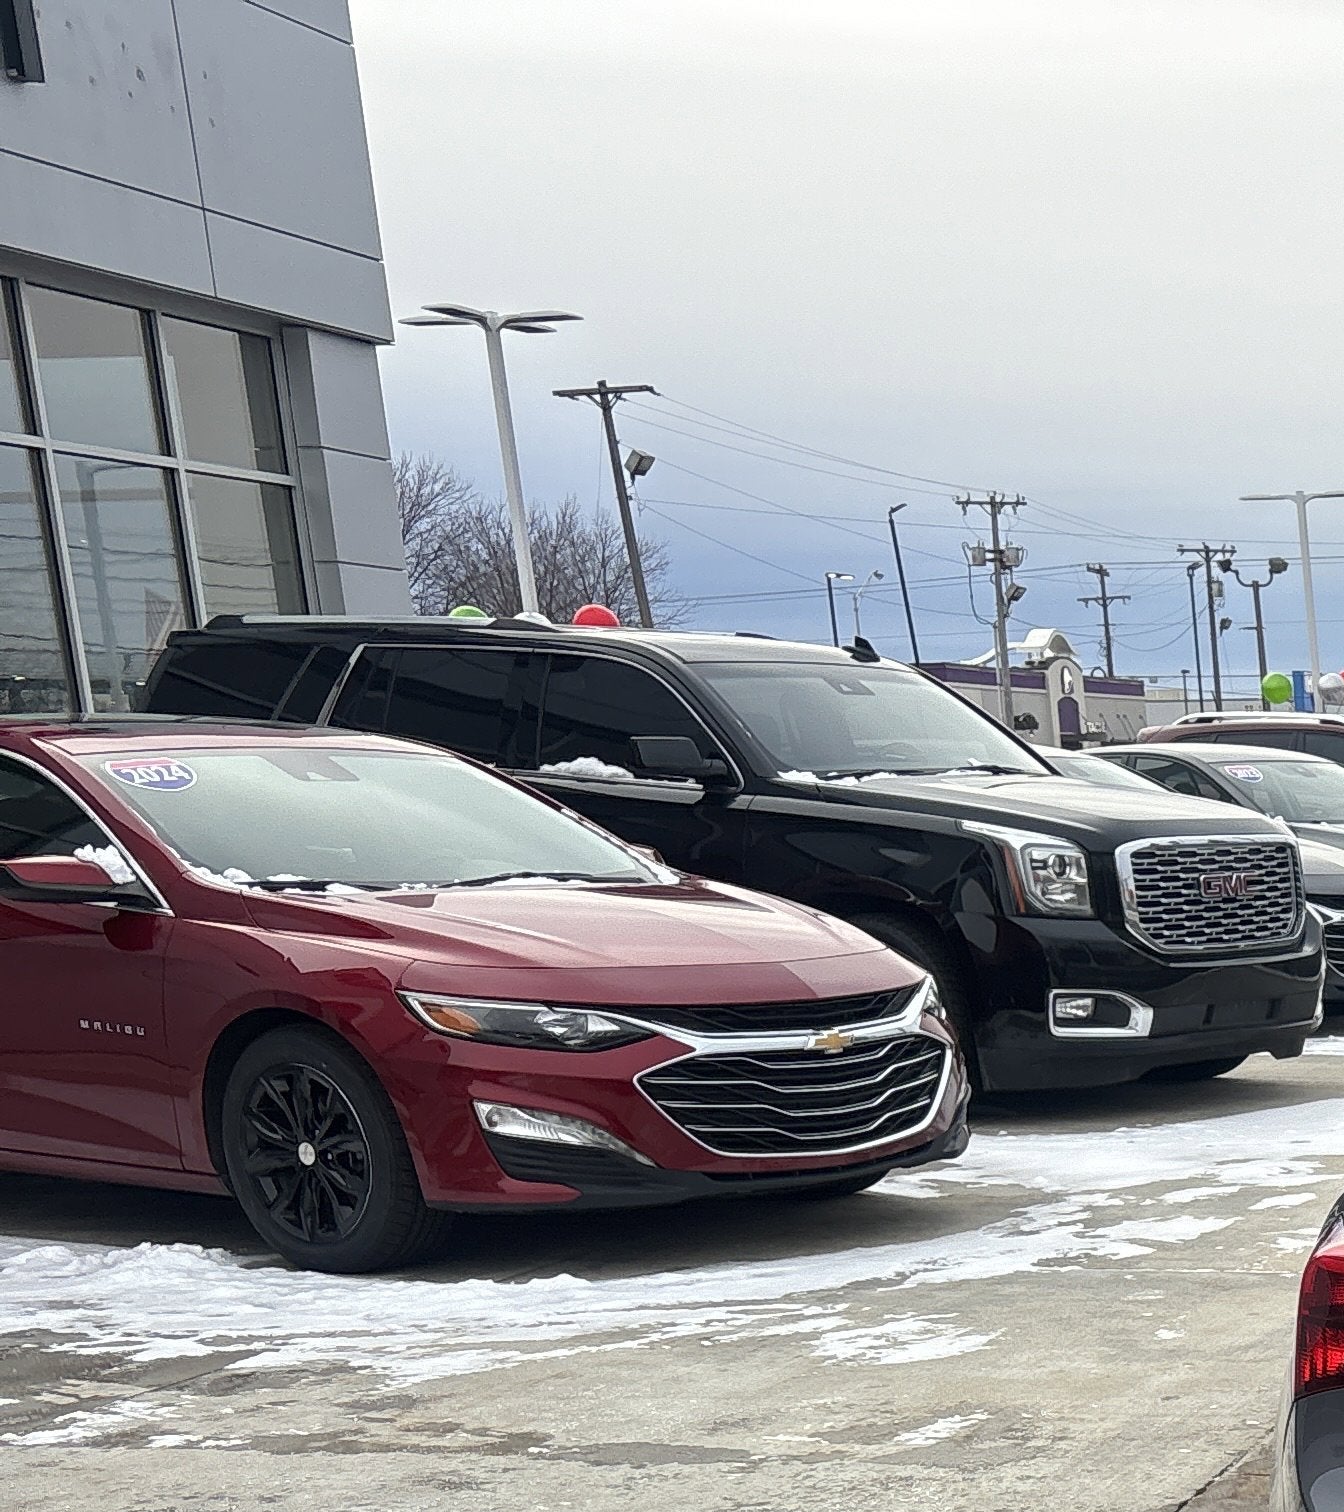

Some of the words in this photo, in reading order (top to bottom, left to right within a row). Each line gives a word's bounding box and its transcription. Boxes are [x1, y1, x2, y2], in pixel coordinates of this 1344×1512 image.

[119, 765, 192, 784] 2024
[1199, 872, 1260, 898] GMC
[79, 1019, 145, 1037] MALIBU
